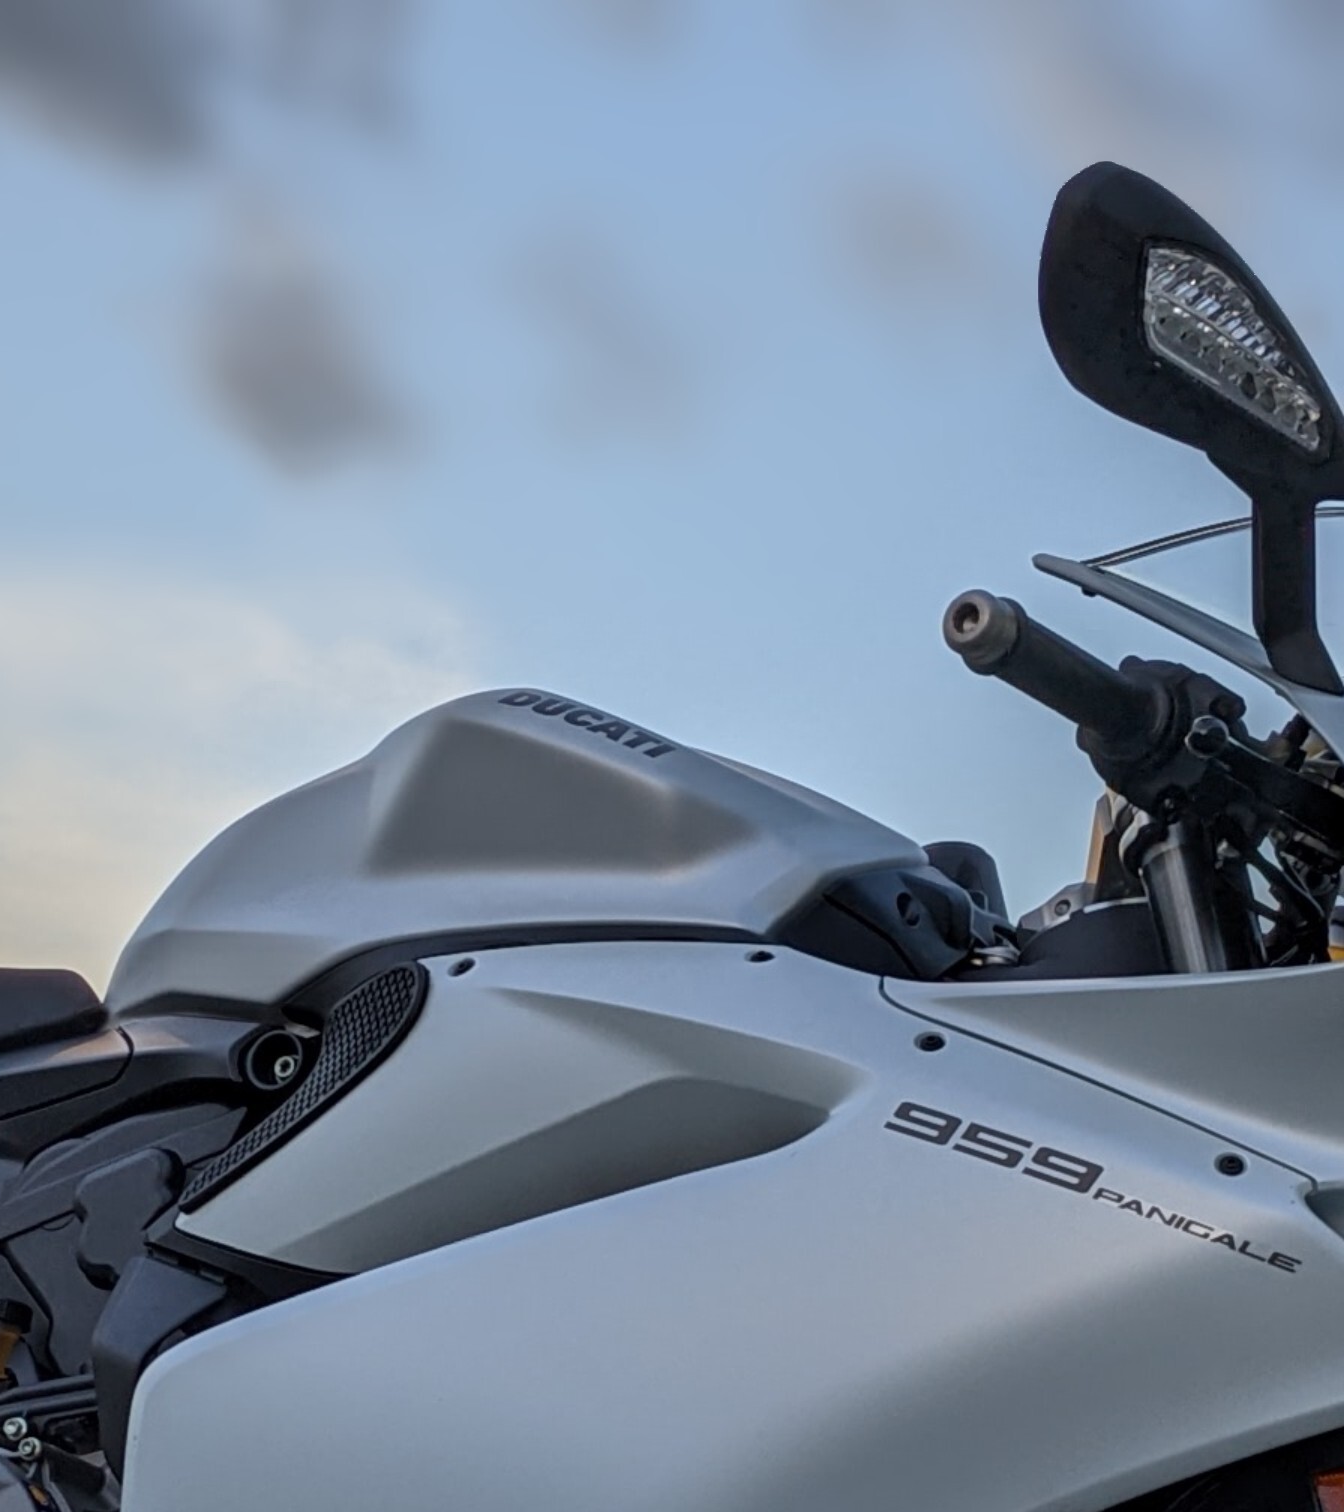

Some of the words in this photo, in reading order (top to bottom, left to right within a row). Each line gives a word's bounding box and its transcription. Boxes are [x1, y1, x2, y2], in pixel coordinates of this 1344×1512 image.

[497, 690, 678, 759] DUCATI
[883, 1101, 1105, 1195] 959
[1092, 1186, 1303, 1274] PANIGALE
